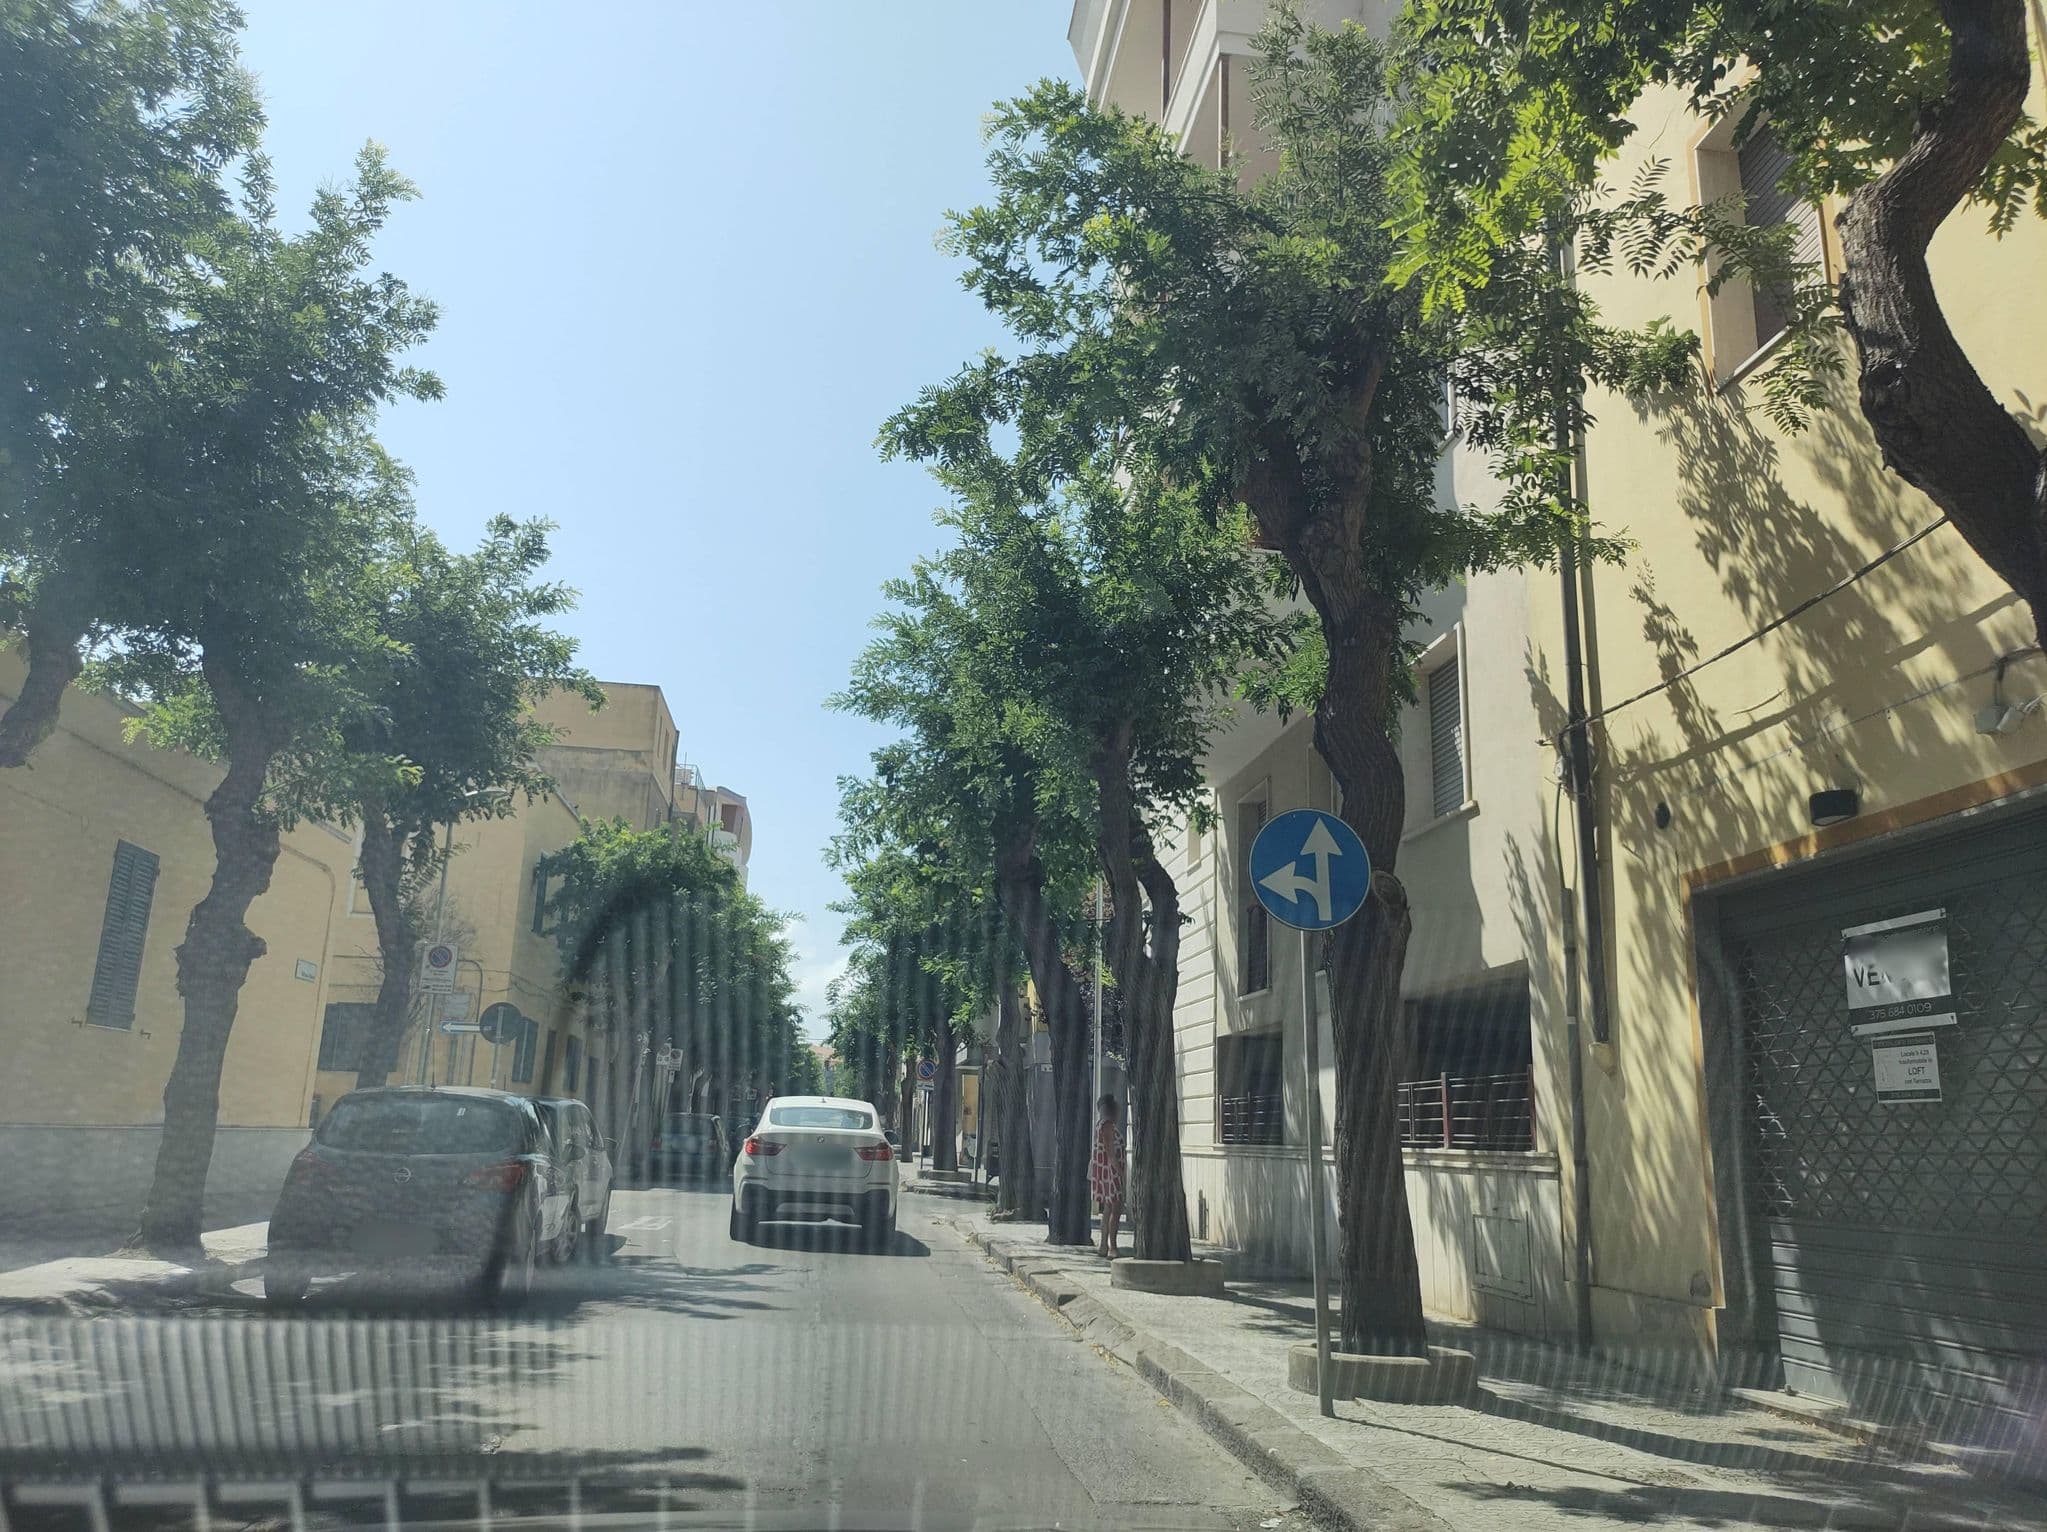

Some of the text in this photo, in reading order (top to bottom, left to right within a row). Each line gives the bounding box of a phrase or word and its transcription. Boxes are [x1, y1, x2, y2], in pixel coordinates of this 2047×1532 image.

[1888, 1006, 1905, 1017] 684
[1906, 1002, 1932, 1015] 0109
[1908, 1066, 1925, 1075] LOFT
